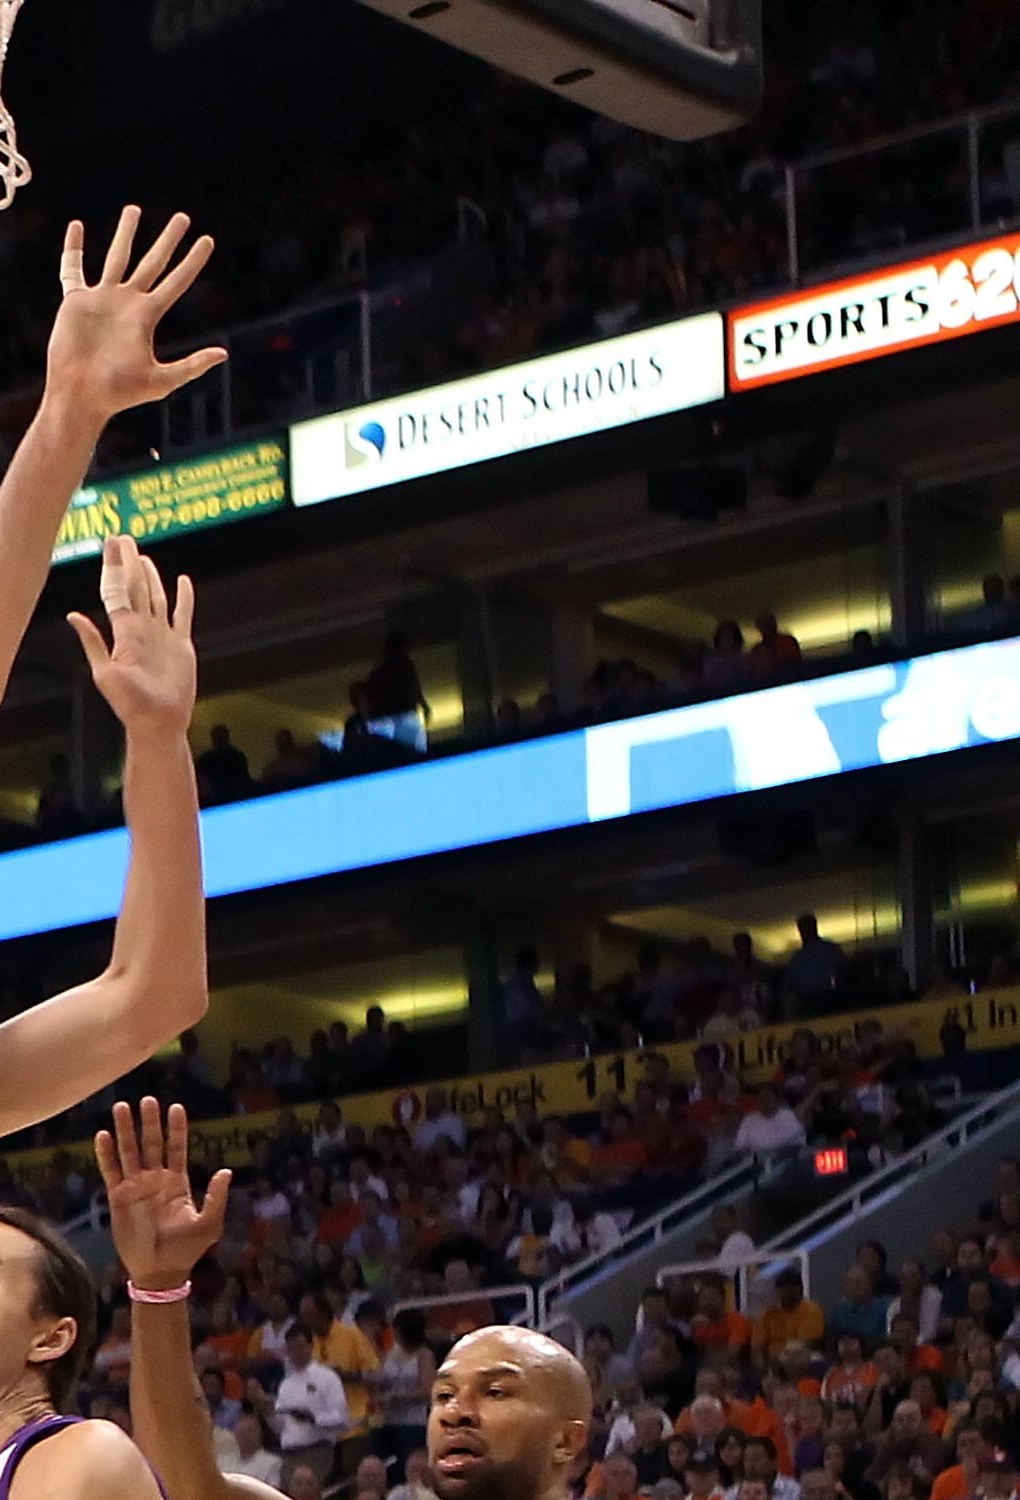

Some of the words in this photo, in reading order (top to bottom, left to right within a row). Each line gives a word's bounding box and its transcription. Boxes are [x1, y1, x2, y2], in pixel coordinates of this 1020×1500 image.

[743, 284, 929, 366] SPORTS
[937, 247, 1020, 330] 62
[396, 391, 510, 453] DESERT
[521, 348, 666, 421] SCHOOLS
[988, 997, 1018, 1032] In
